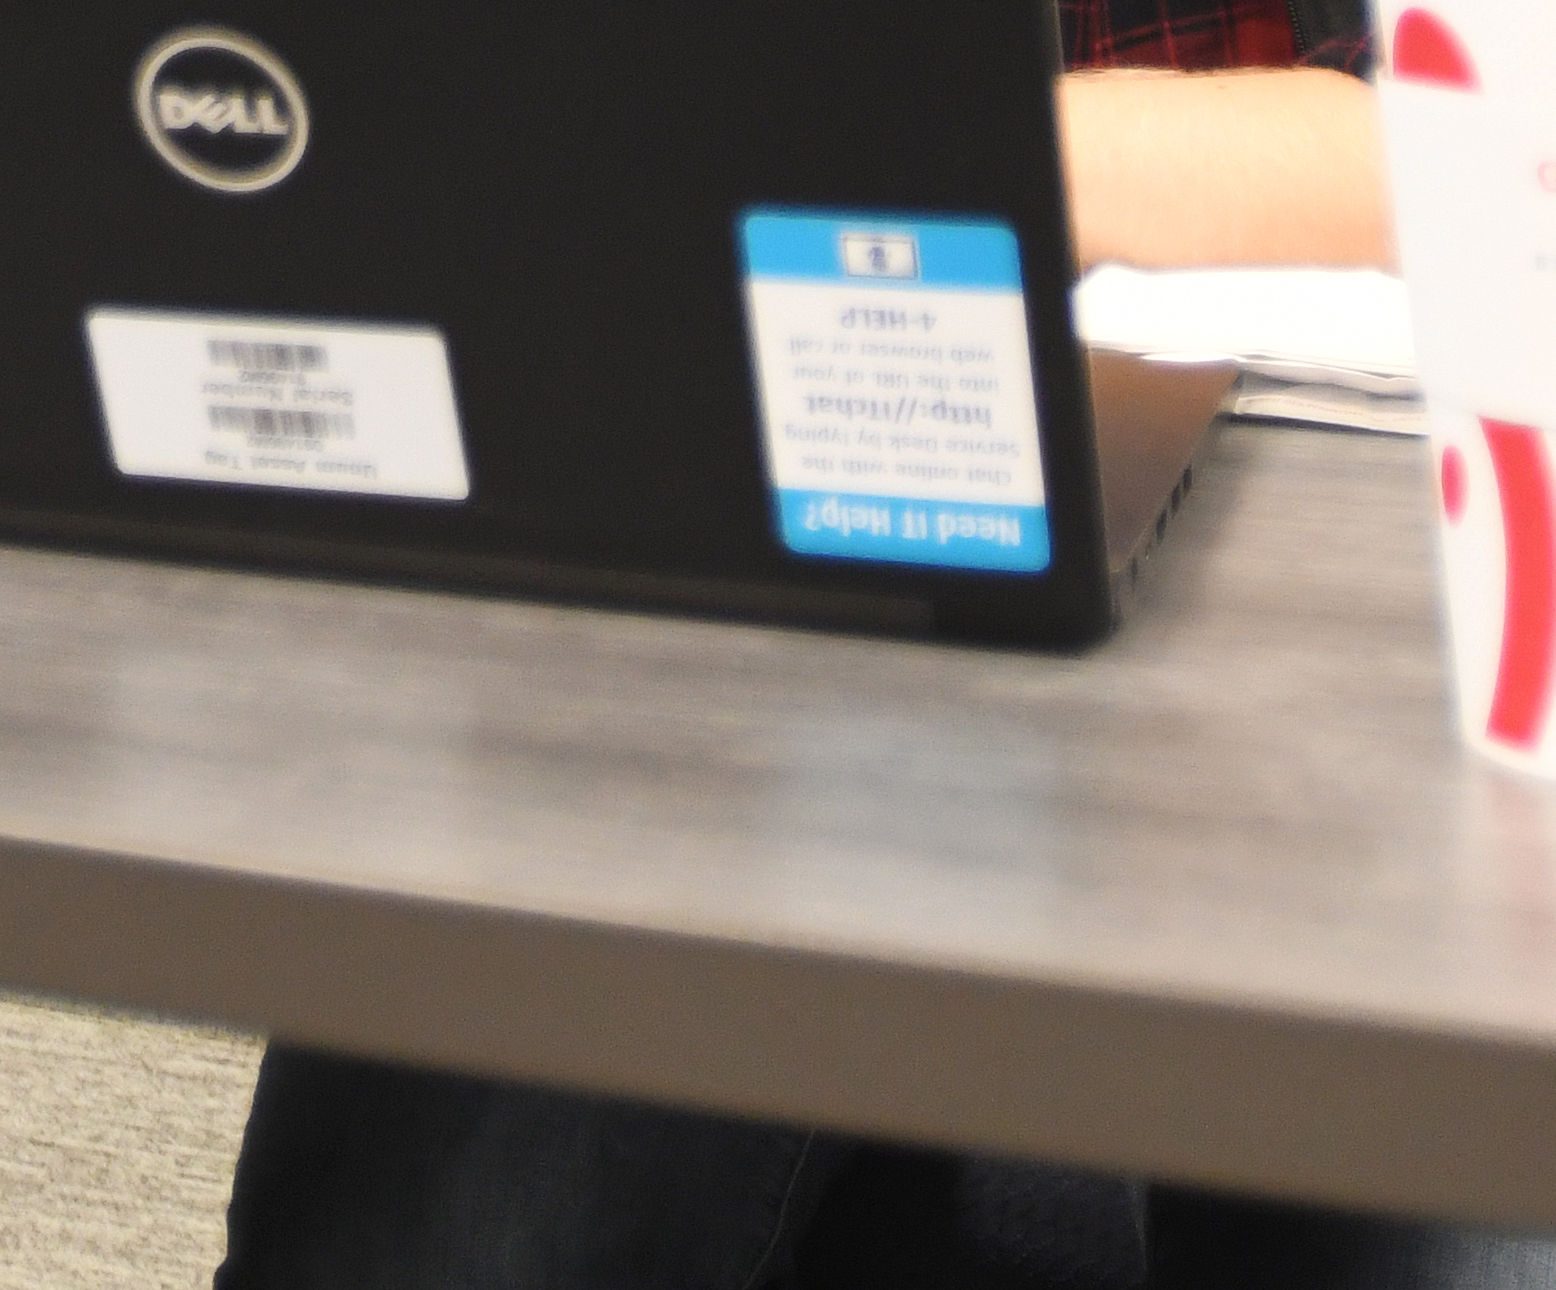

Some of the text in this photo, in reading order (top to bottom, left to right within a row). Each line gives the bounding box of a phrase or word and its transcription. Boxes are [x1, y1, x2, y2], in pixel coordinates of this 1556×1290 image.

[159, 86, 288, 136] DELL
[803, 498, 1022, 547] Need IT Help?
